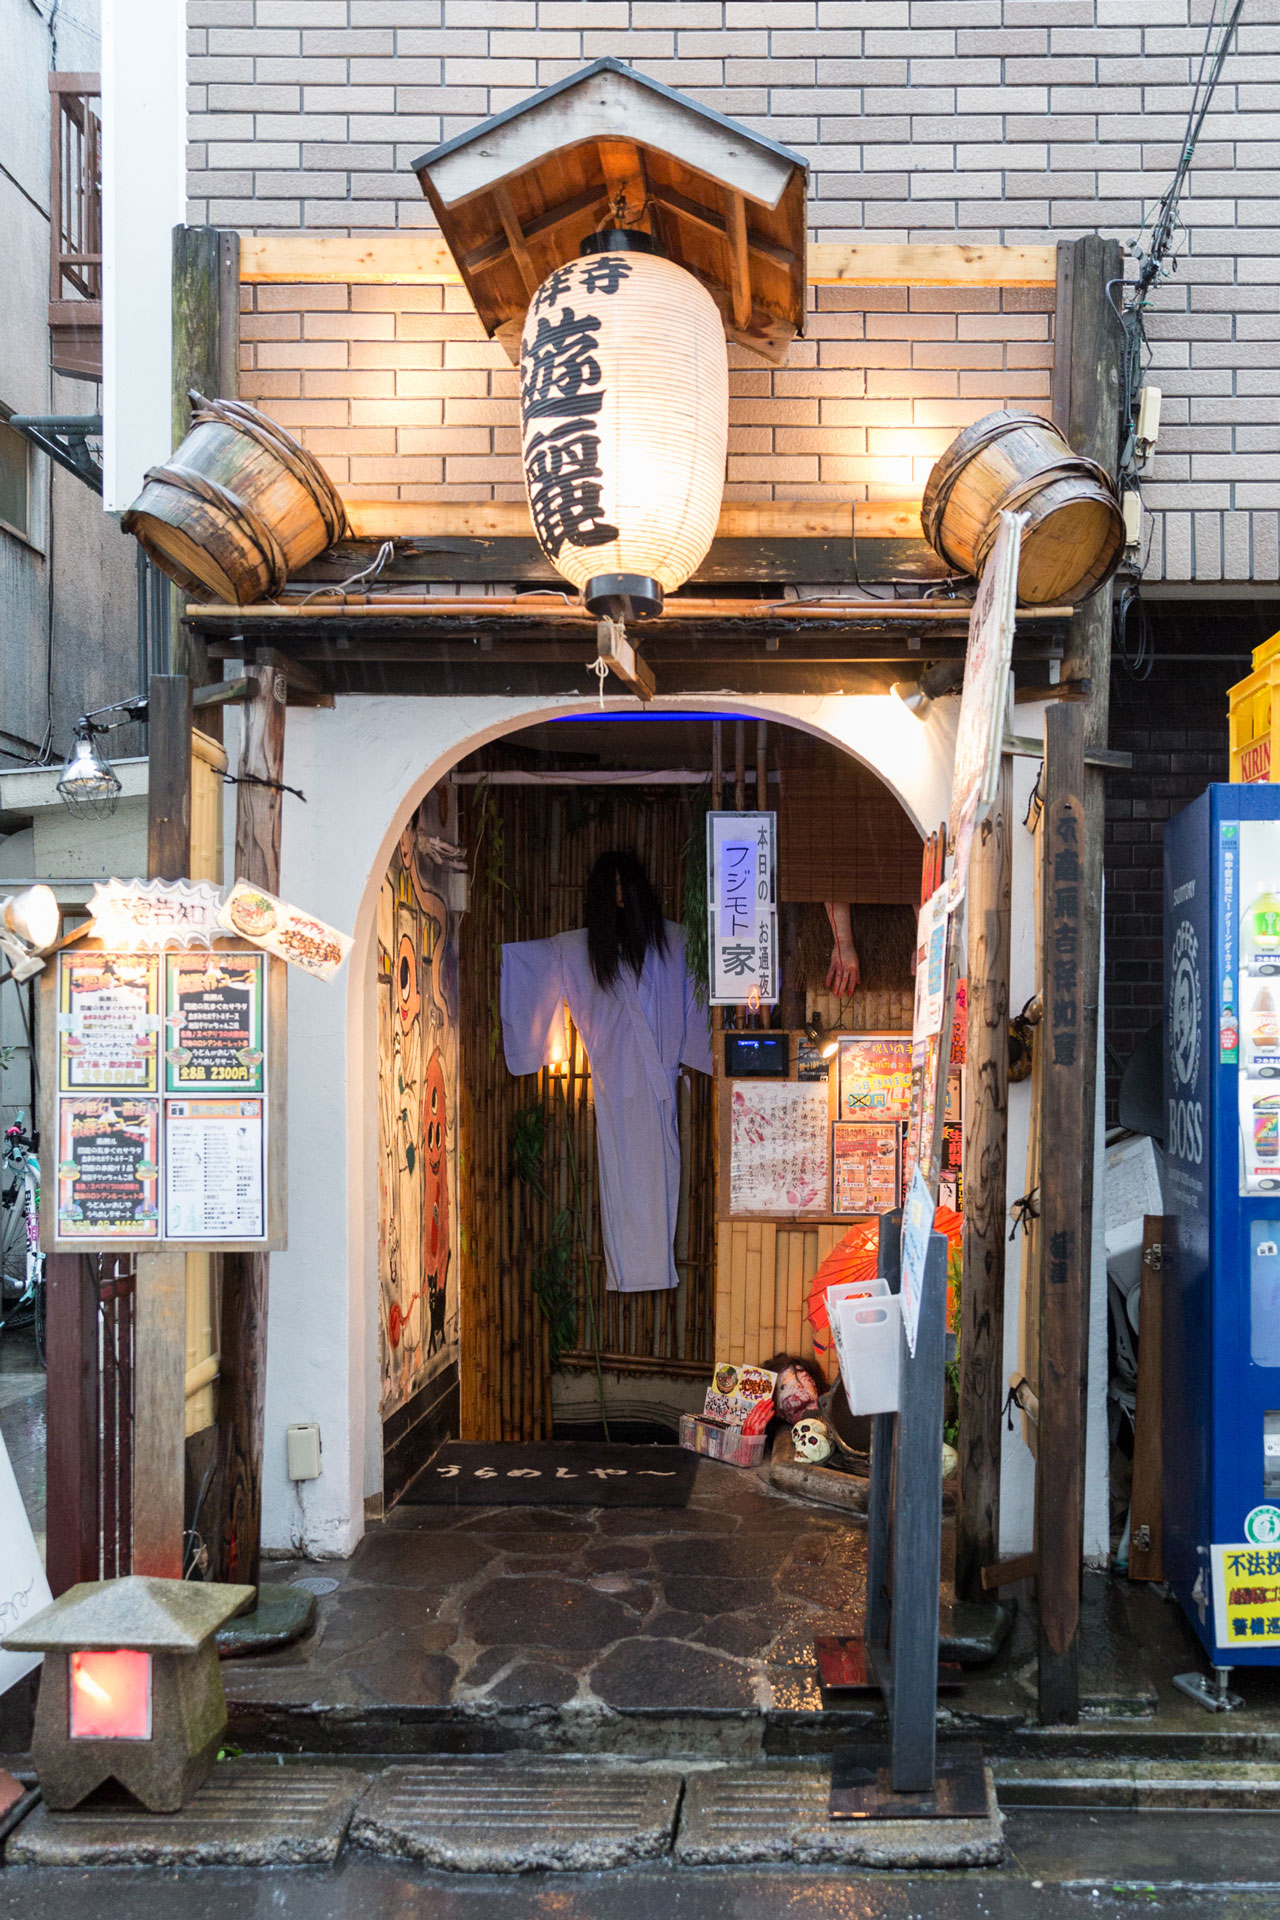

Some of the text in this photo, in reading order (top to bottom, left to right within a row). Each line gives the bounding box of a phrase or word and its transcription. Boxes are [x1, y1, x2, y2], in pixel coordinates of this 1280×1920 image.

[1240, 739, 1271, 782] KIRIN
[210, 1067, 248, 1080] 2300円
[1168, 1098, 1204, 1165] BOSS
[1227, 1551, 1280, 1577] 不法投
